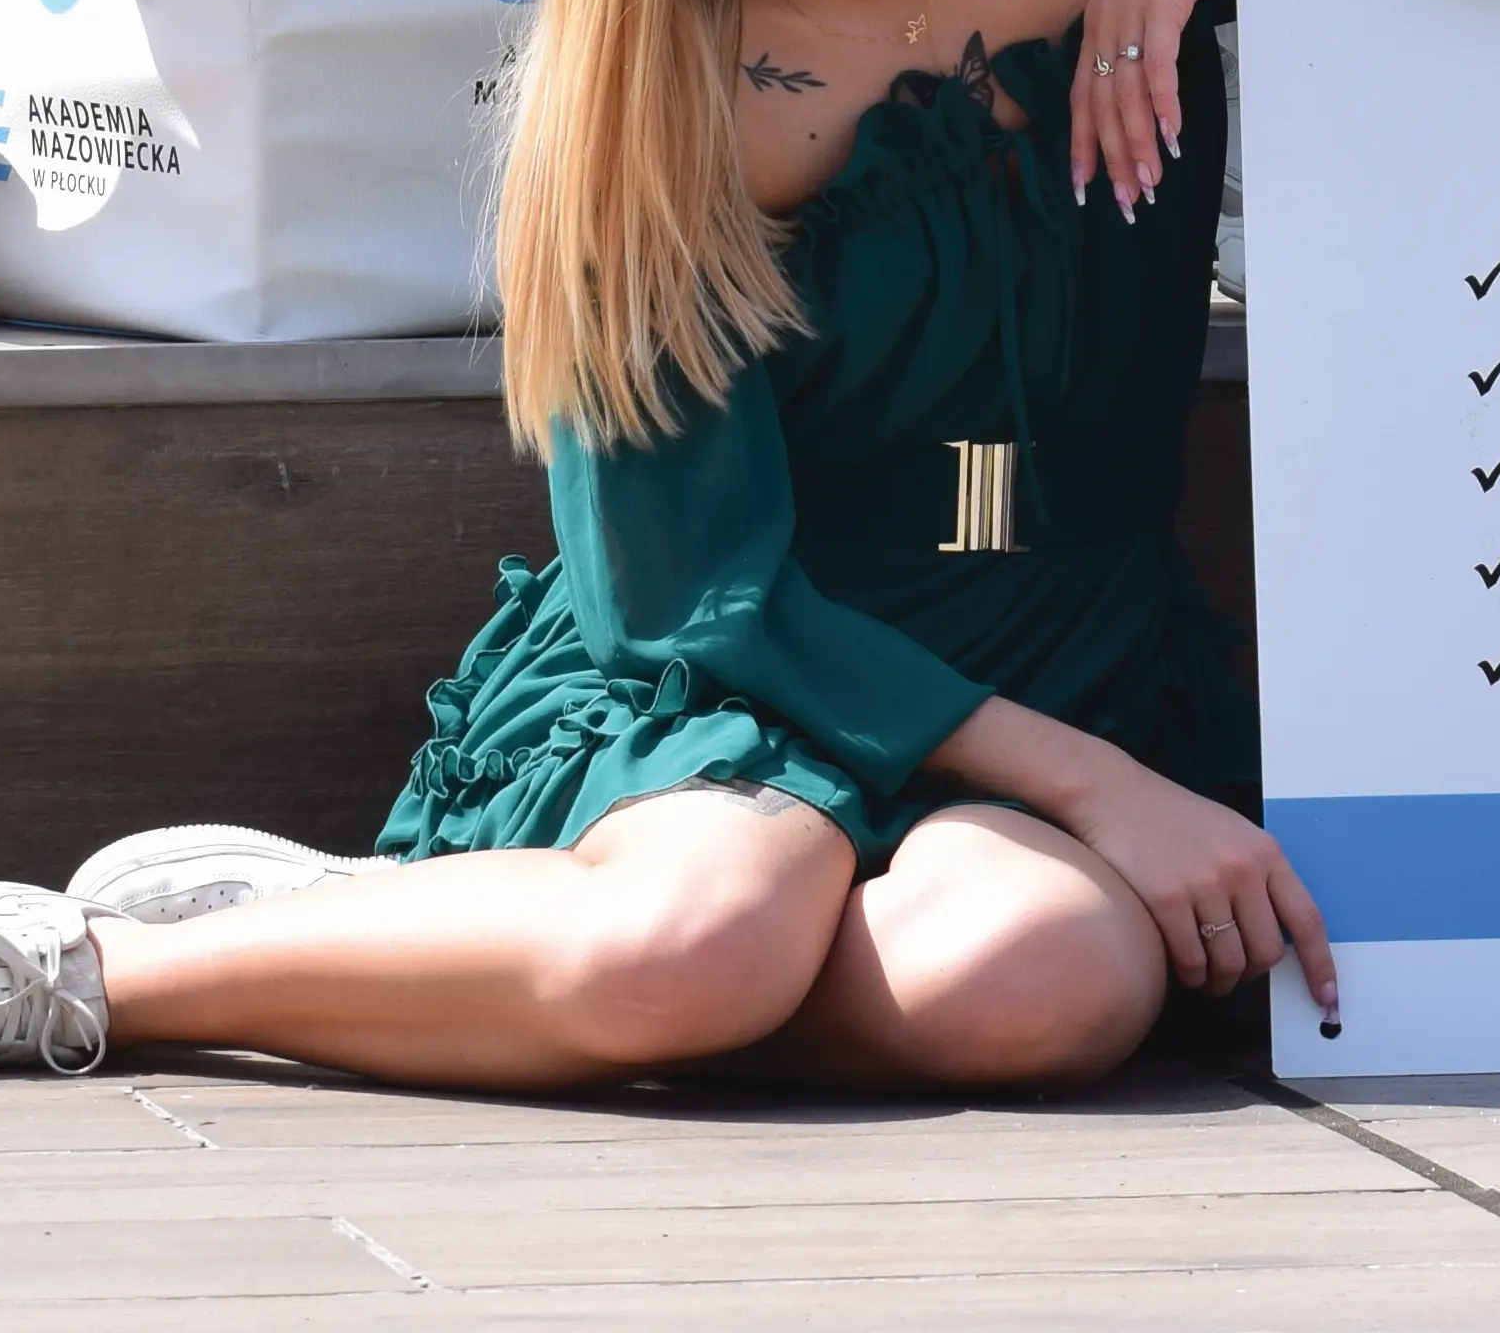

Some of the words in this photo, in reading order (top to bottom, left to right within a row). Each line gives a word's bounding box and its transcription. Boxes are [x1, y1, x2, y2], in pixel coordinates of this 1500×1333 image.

[28, 93, 154, 138] AKADEMIA
[31, 128, 181, 175] MAZOWIECKA
[32, 167, 46, 189] W
[50, 170, 106, 197] PŁOCKU
